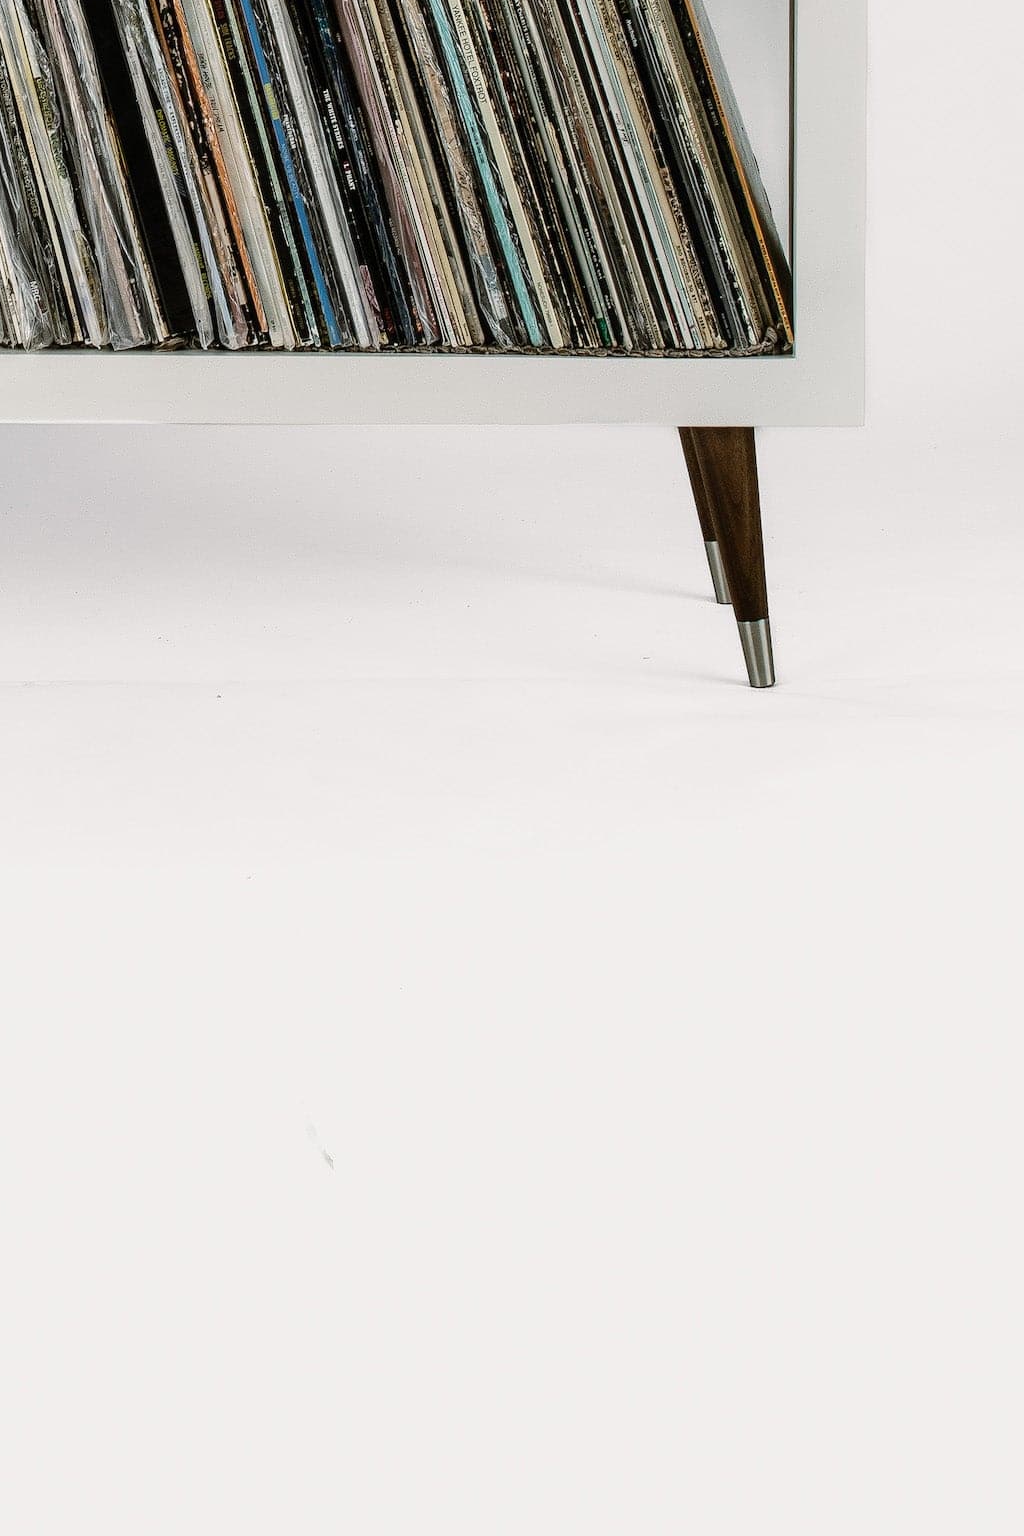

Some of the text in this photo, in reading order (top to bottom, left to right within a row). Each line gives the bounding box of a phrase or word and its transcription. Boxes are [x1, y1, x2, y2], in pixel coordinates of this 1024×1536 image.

[449, 4, 468, 37] YANKEE
[460, 38, 477, 66] HOTEL
[468, 66, 489, 104] FOXTROT
